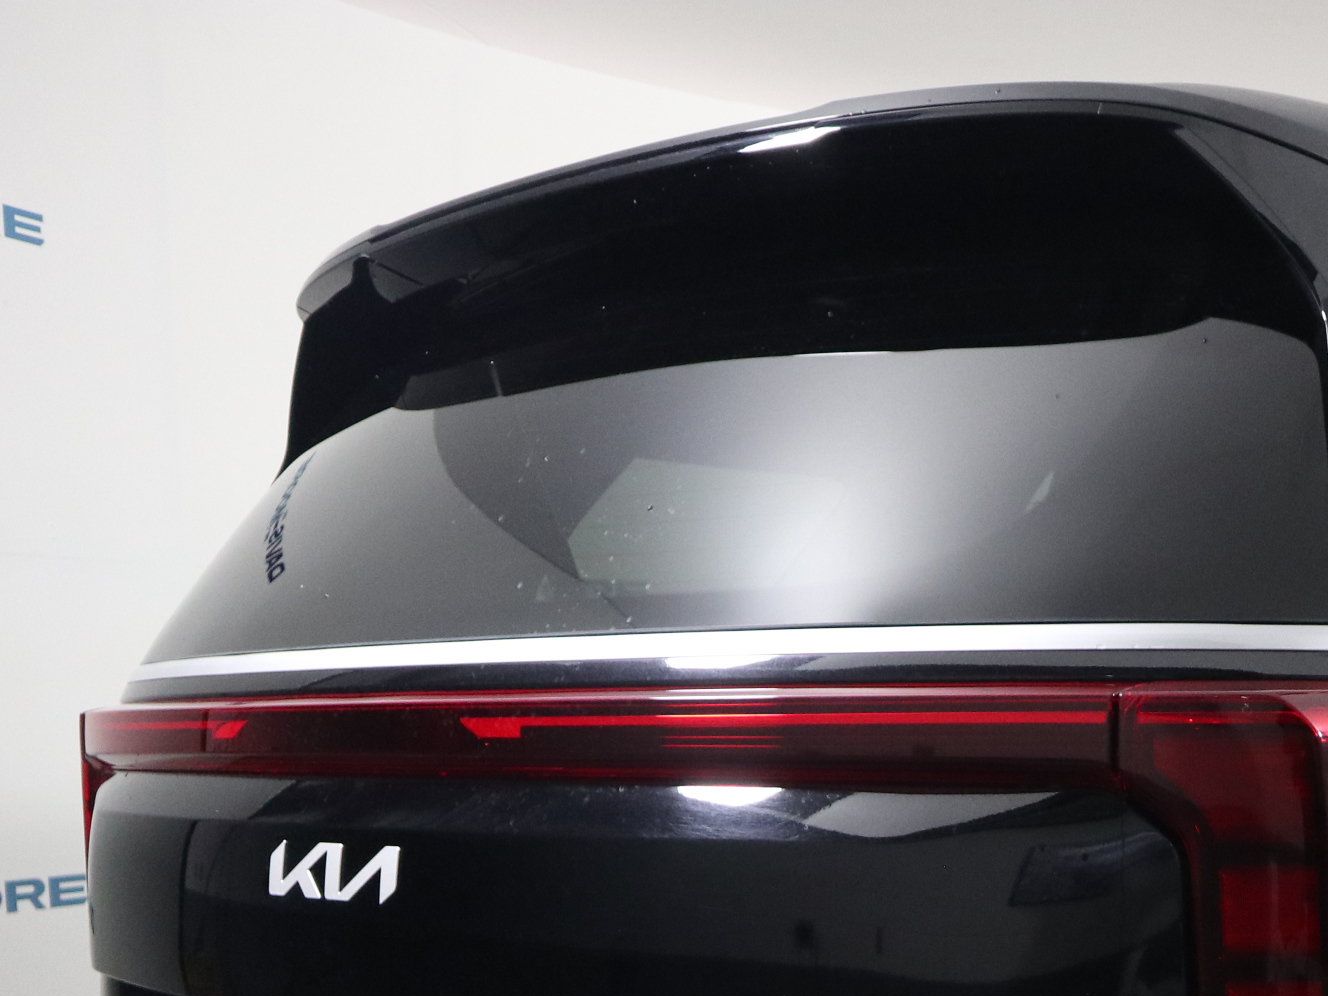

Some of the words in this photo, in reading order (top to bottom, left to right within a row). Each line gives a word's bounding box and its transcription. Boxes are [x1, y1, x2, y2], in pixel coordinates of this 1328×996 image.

[2, 203, 45, 246] E
[0, 873, 87, 912] RE
[268, 839, 401, 905] KIA
